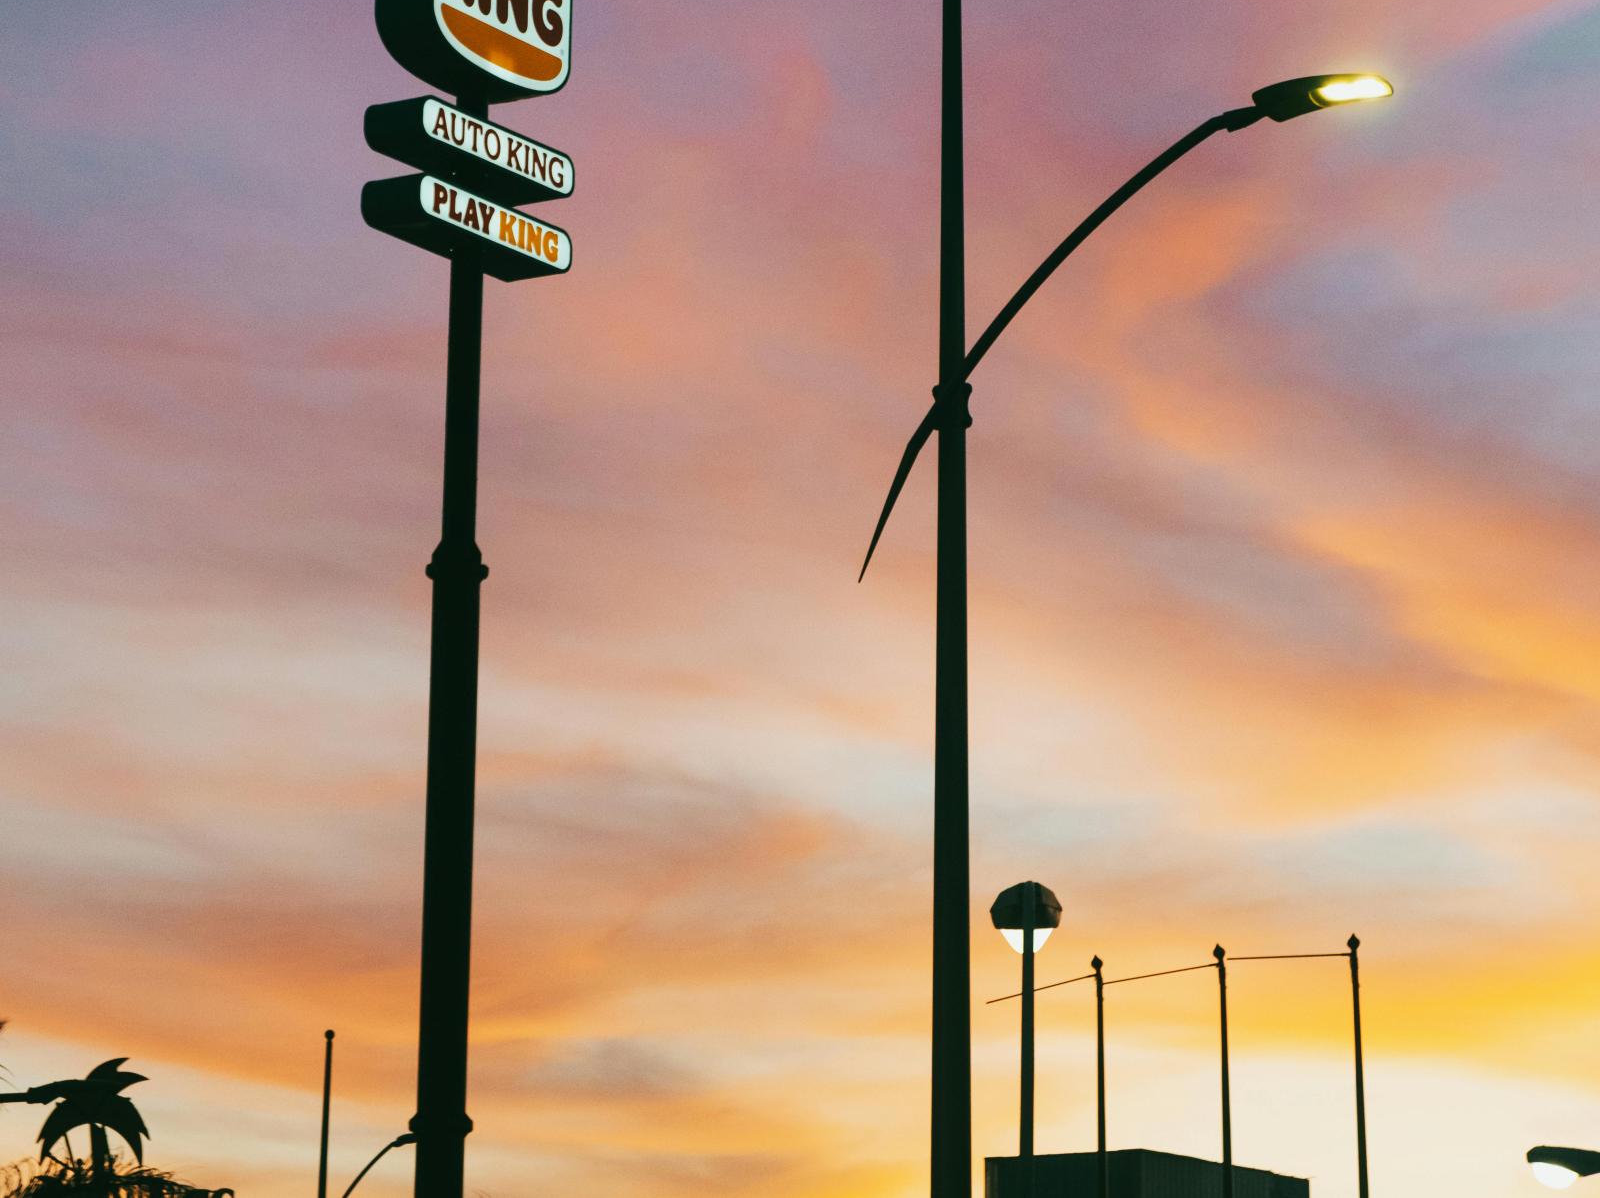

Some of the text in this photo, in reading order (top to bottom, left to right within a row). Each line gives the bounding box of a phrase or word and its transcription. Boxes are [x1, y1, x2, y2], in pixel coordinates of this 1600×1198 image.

[432, 107, 564, 189] AUTO KING
[432, 182, 559, 263] PLAY KING
